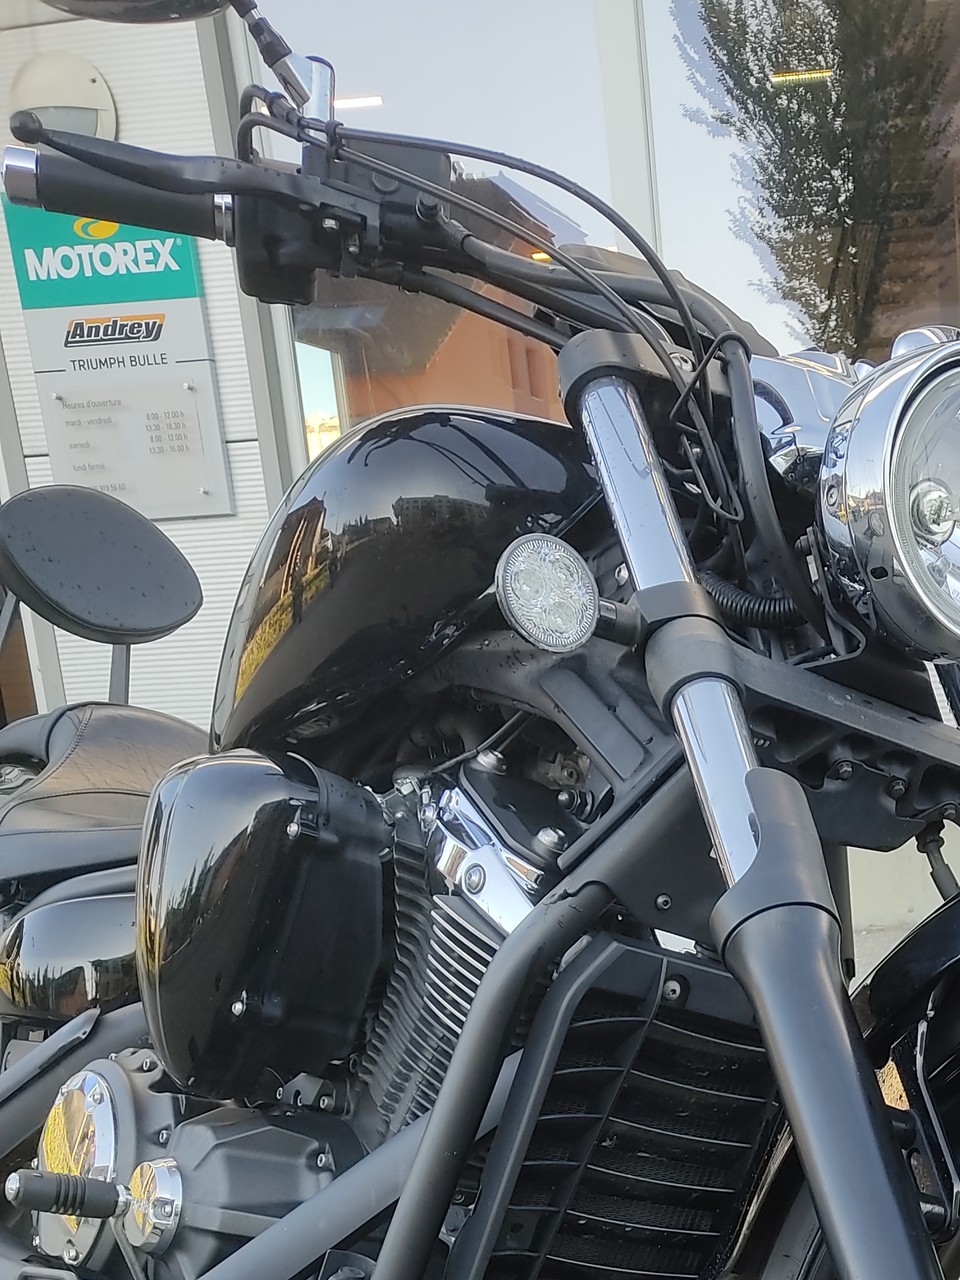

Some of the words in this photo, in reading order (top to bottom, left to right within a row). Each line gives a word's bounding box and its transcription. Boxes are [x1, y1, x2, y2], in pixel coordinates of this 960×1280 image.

[24, 237, 181, 281] MOTOREX
[69, 318, 159, 343] Andrey
[70, 356, 126, 373] TRIUMPH
[130, 352, 169, 366] BULLE
[62, 400, 86, 410] Heures
